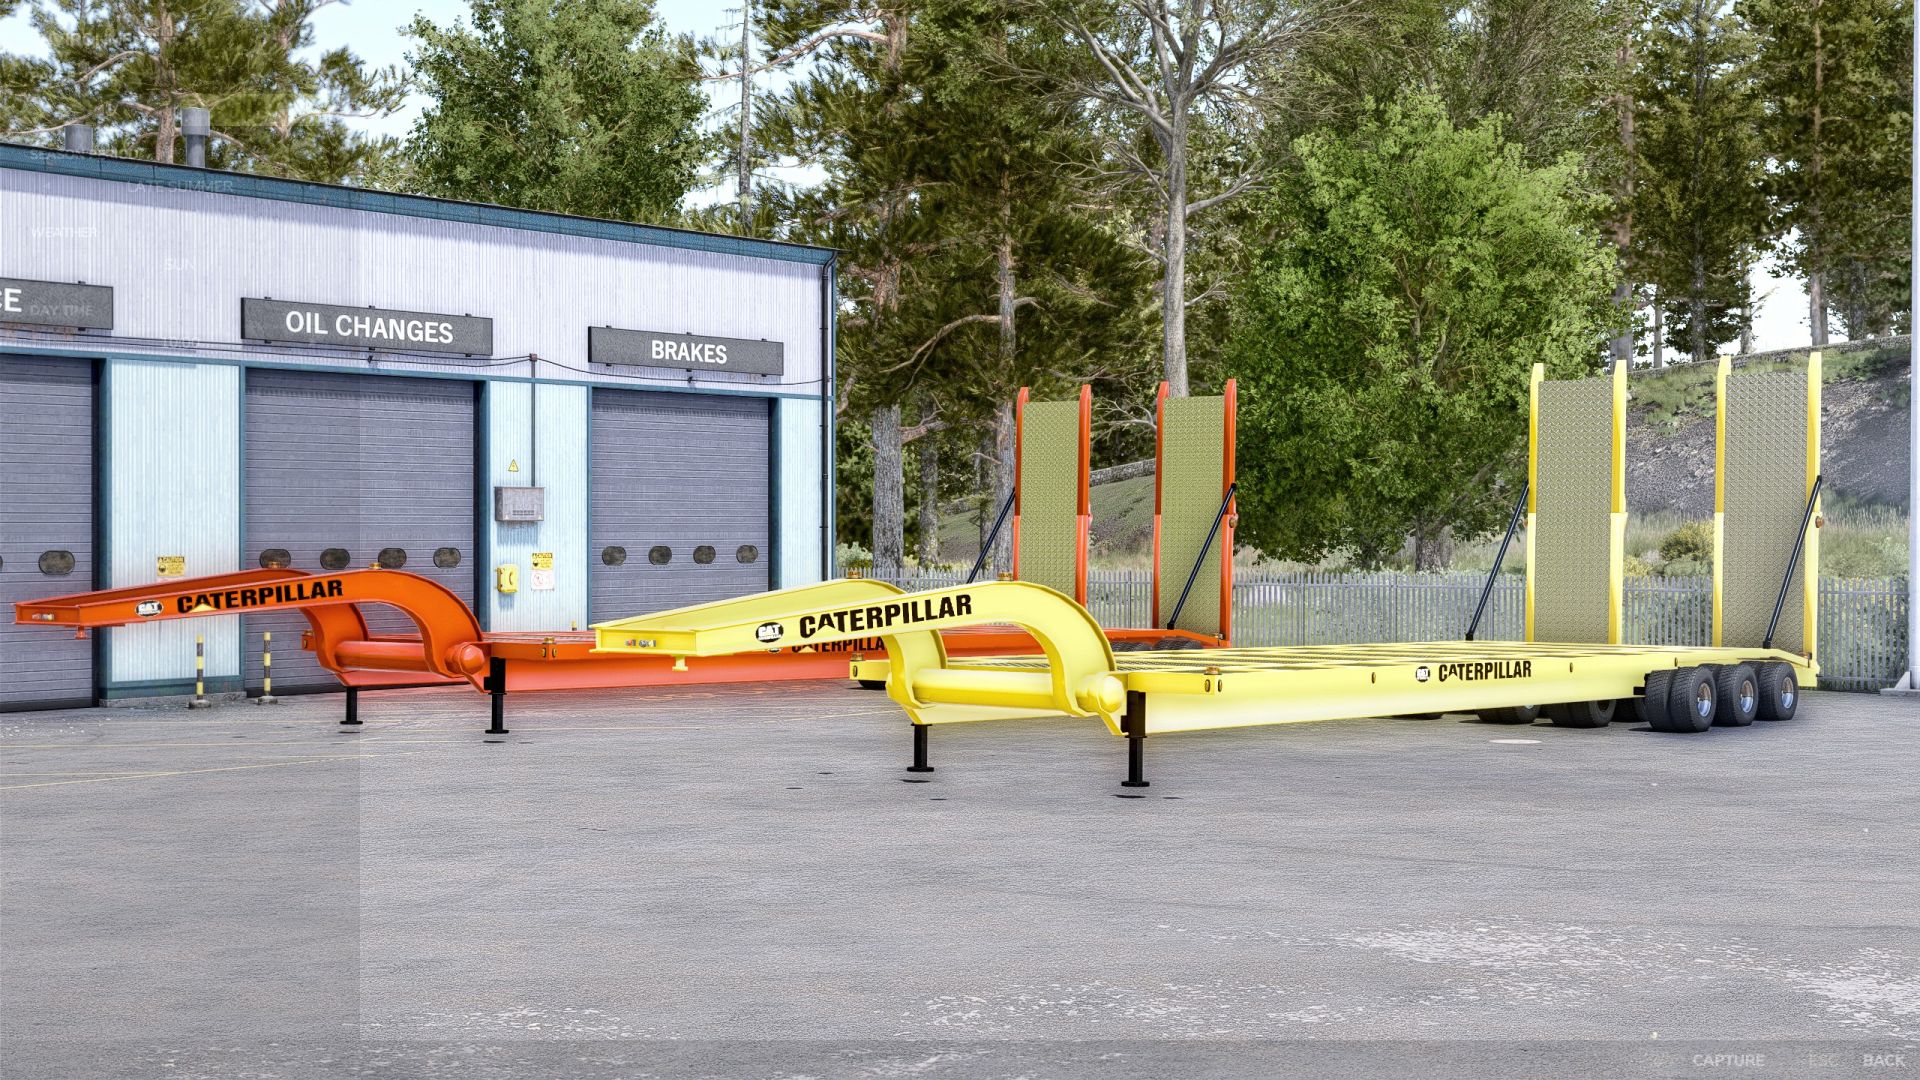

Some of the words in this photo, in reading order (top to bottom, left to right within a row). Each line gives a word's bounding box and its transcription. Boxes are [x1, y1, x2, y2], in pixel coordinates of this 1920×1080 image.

[0, 287, 22, 312] E
[286, 311, 328, 335] OIL
[335, 314, 454, 344] CHANGES
[651, 340, 728, 364] BRAKES
[177, 579, 343, 614] CATERPILLAR
[799, 594, 972, 639] CATERPILLAR
[758, 624, 781, 637] CAT
[1438, 660, 1532, 682] CATERPILLAR
